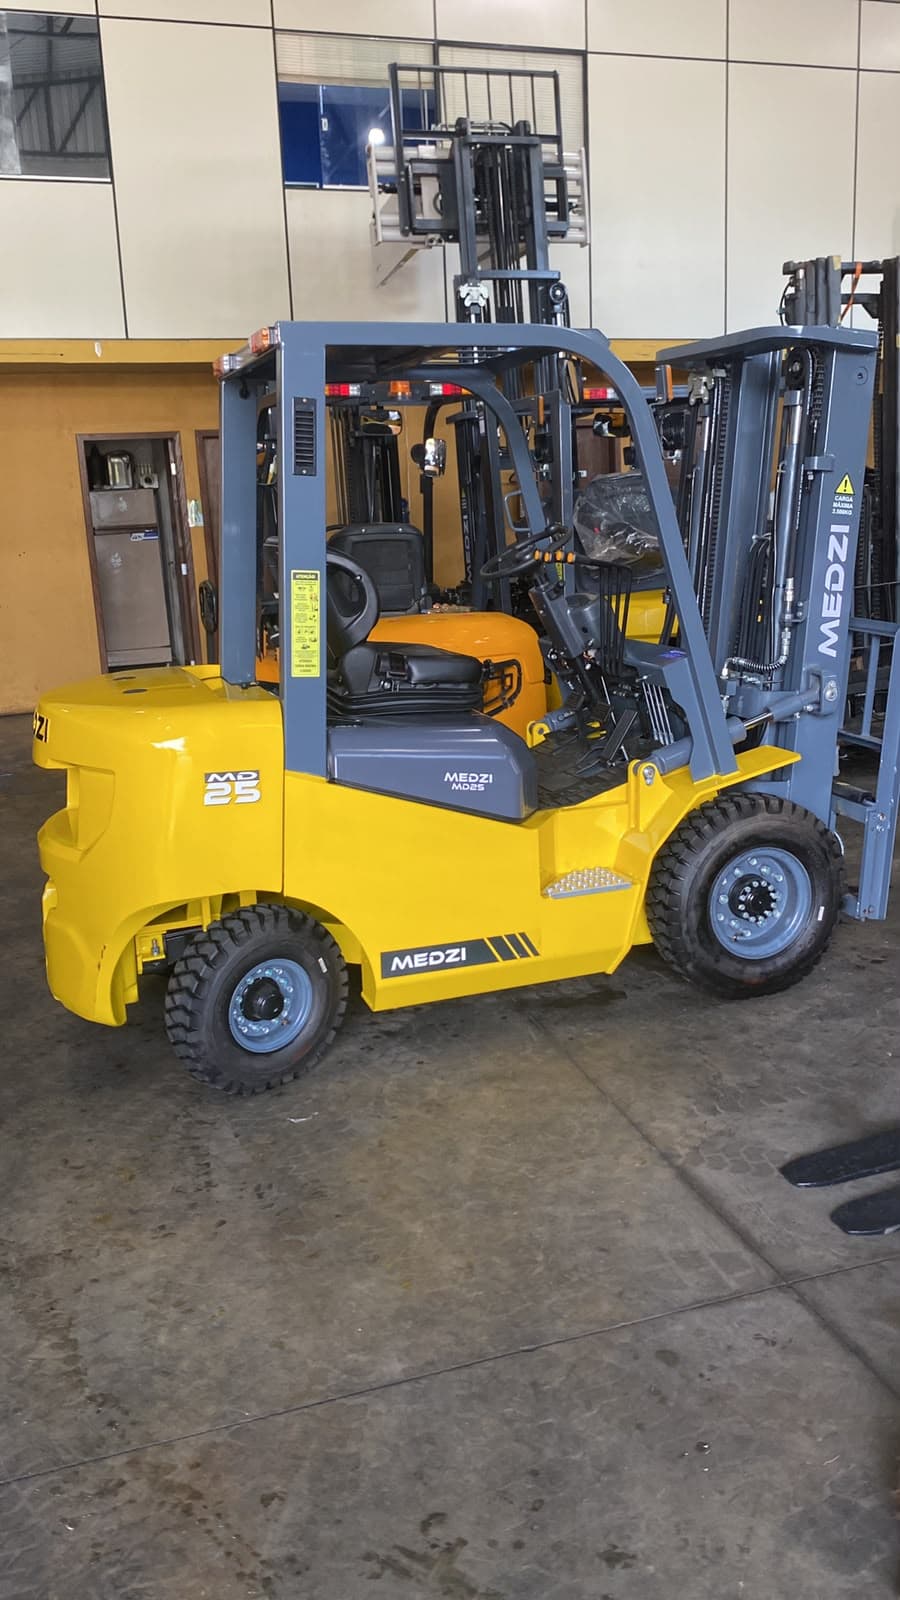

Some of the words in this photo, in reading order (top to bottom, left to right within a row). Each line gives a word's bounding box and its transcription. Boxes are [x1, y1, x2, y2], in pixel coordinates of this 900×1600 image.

[818, 524, 850, 658] MEDZI
[207, 771, 258, 783] MD
[443, 771, 493, 784] MEDZI
[451, 782, 485, 791] MD25
[203, 780, 261, 806] 25
[390, 947, 467, 972] MEDZI
